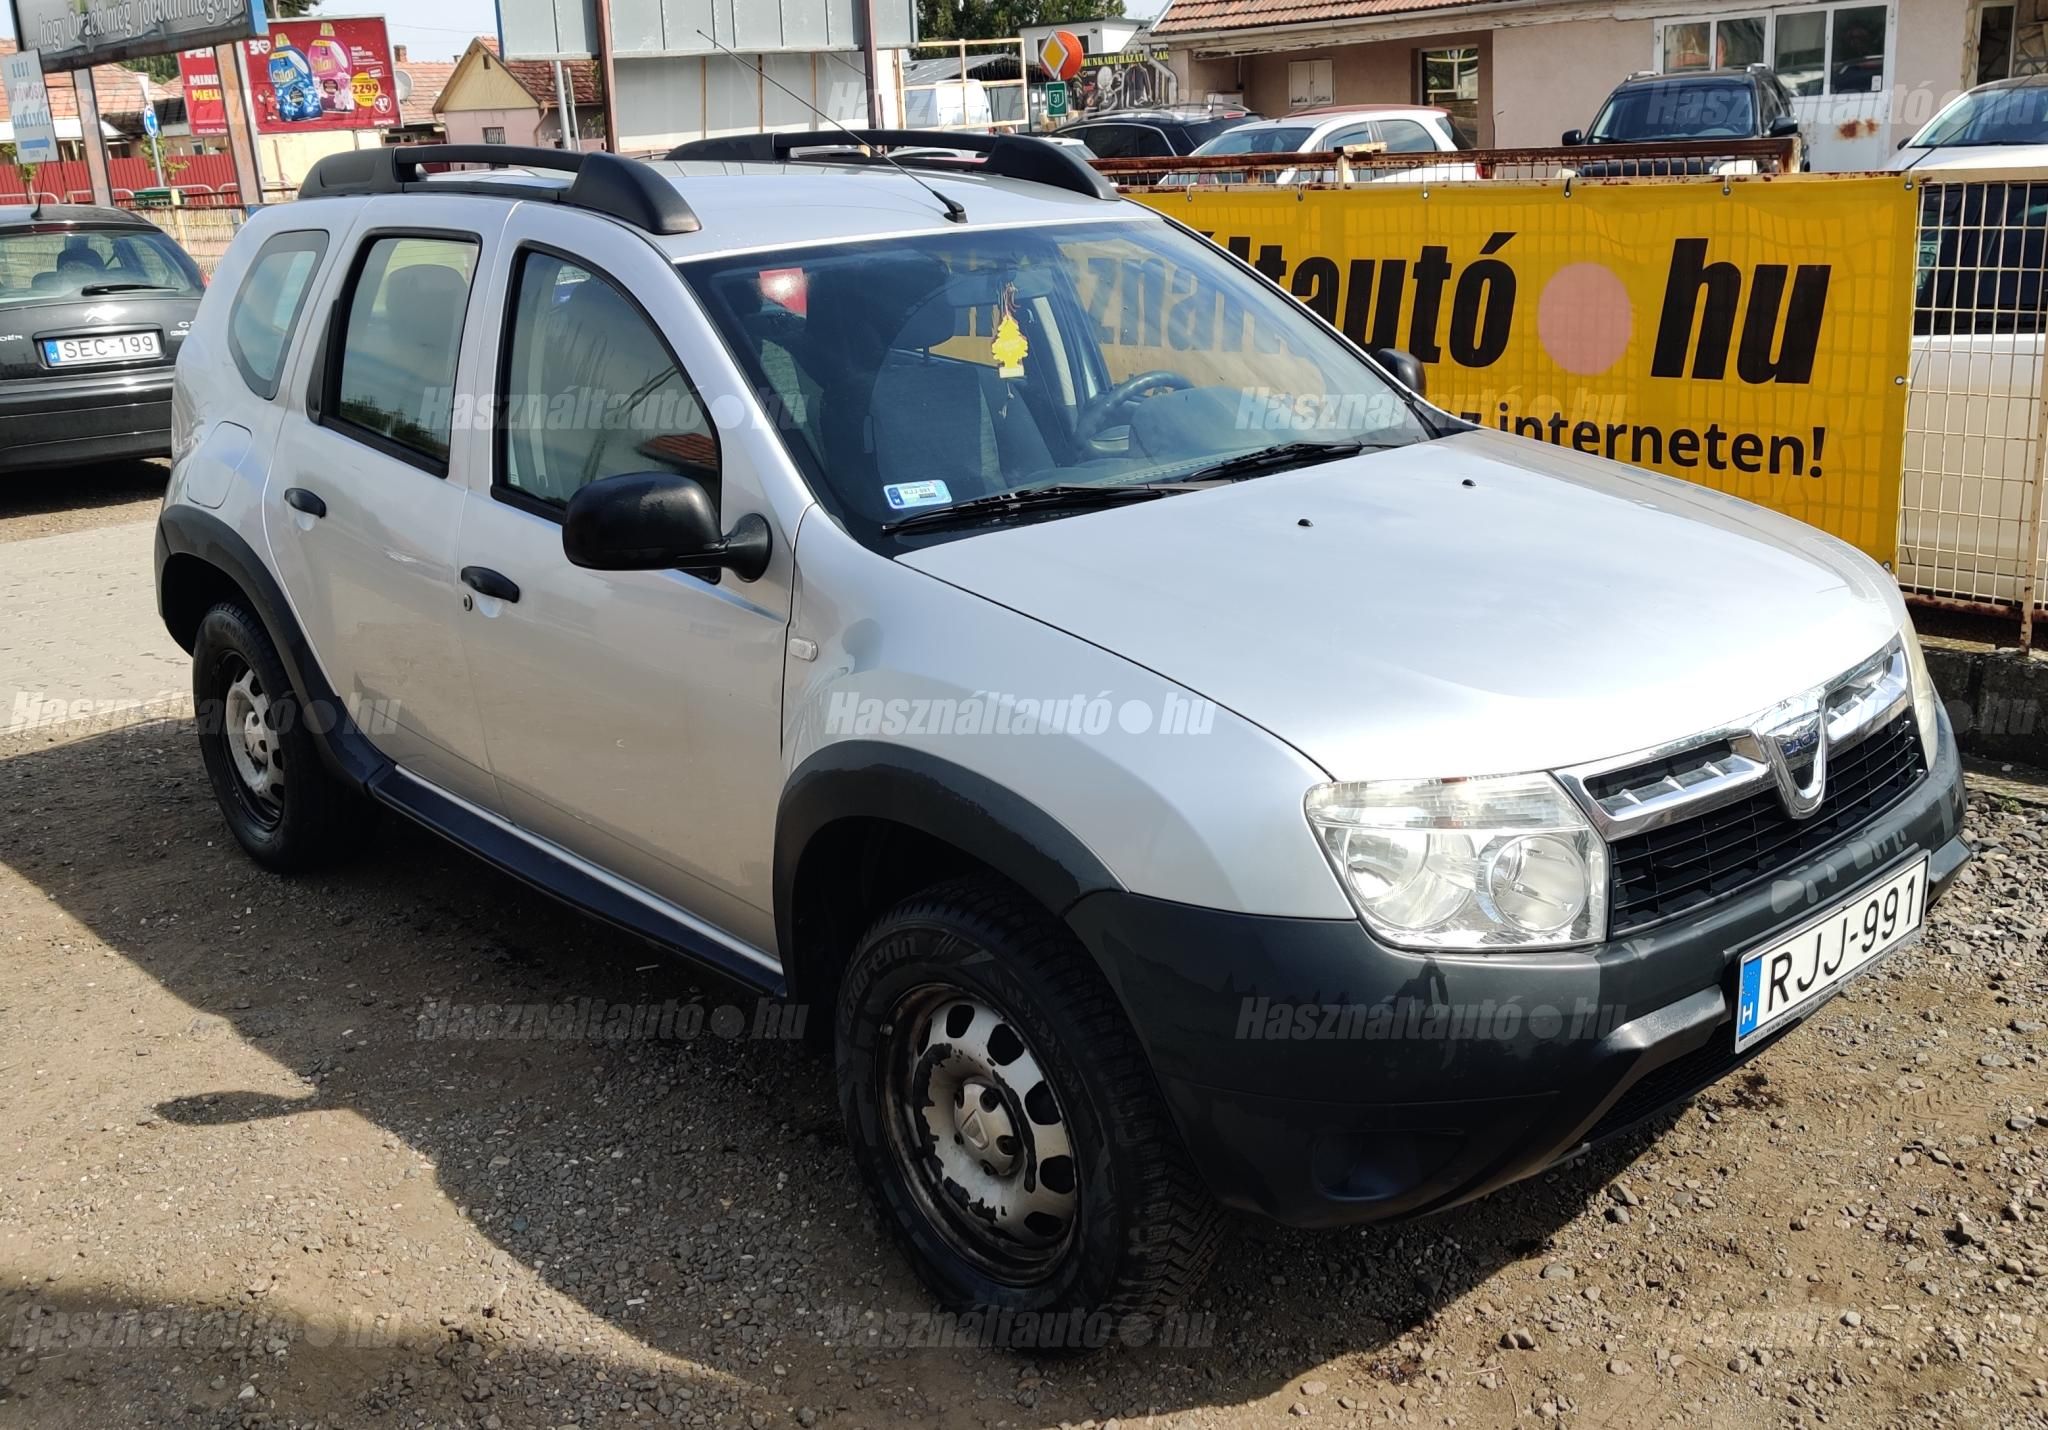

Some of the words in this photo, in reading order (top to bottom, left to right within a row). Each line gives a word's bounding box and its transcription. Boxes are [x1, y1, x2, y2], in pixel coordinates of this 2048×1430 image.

[352, 83, 379, 95] 2299
[1052, 93, 1061, 104] 31
[63, 335, 154, 359] SEC-199
[1499, 402, 1826, 478] interneten!
[1766, 874, 1916, 1012] RJJ-991
[1741, 1002, 1754, 1025] H
